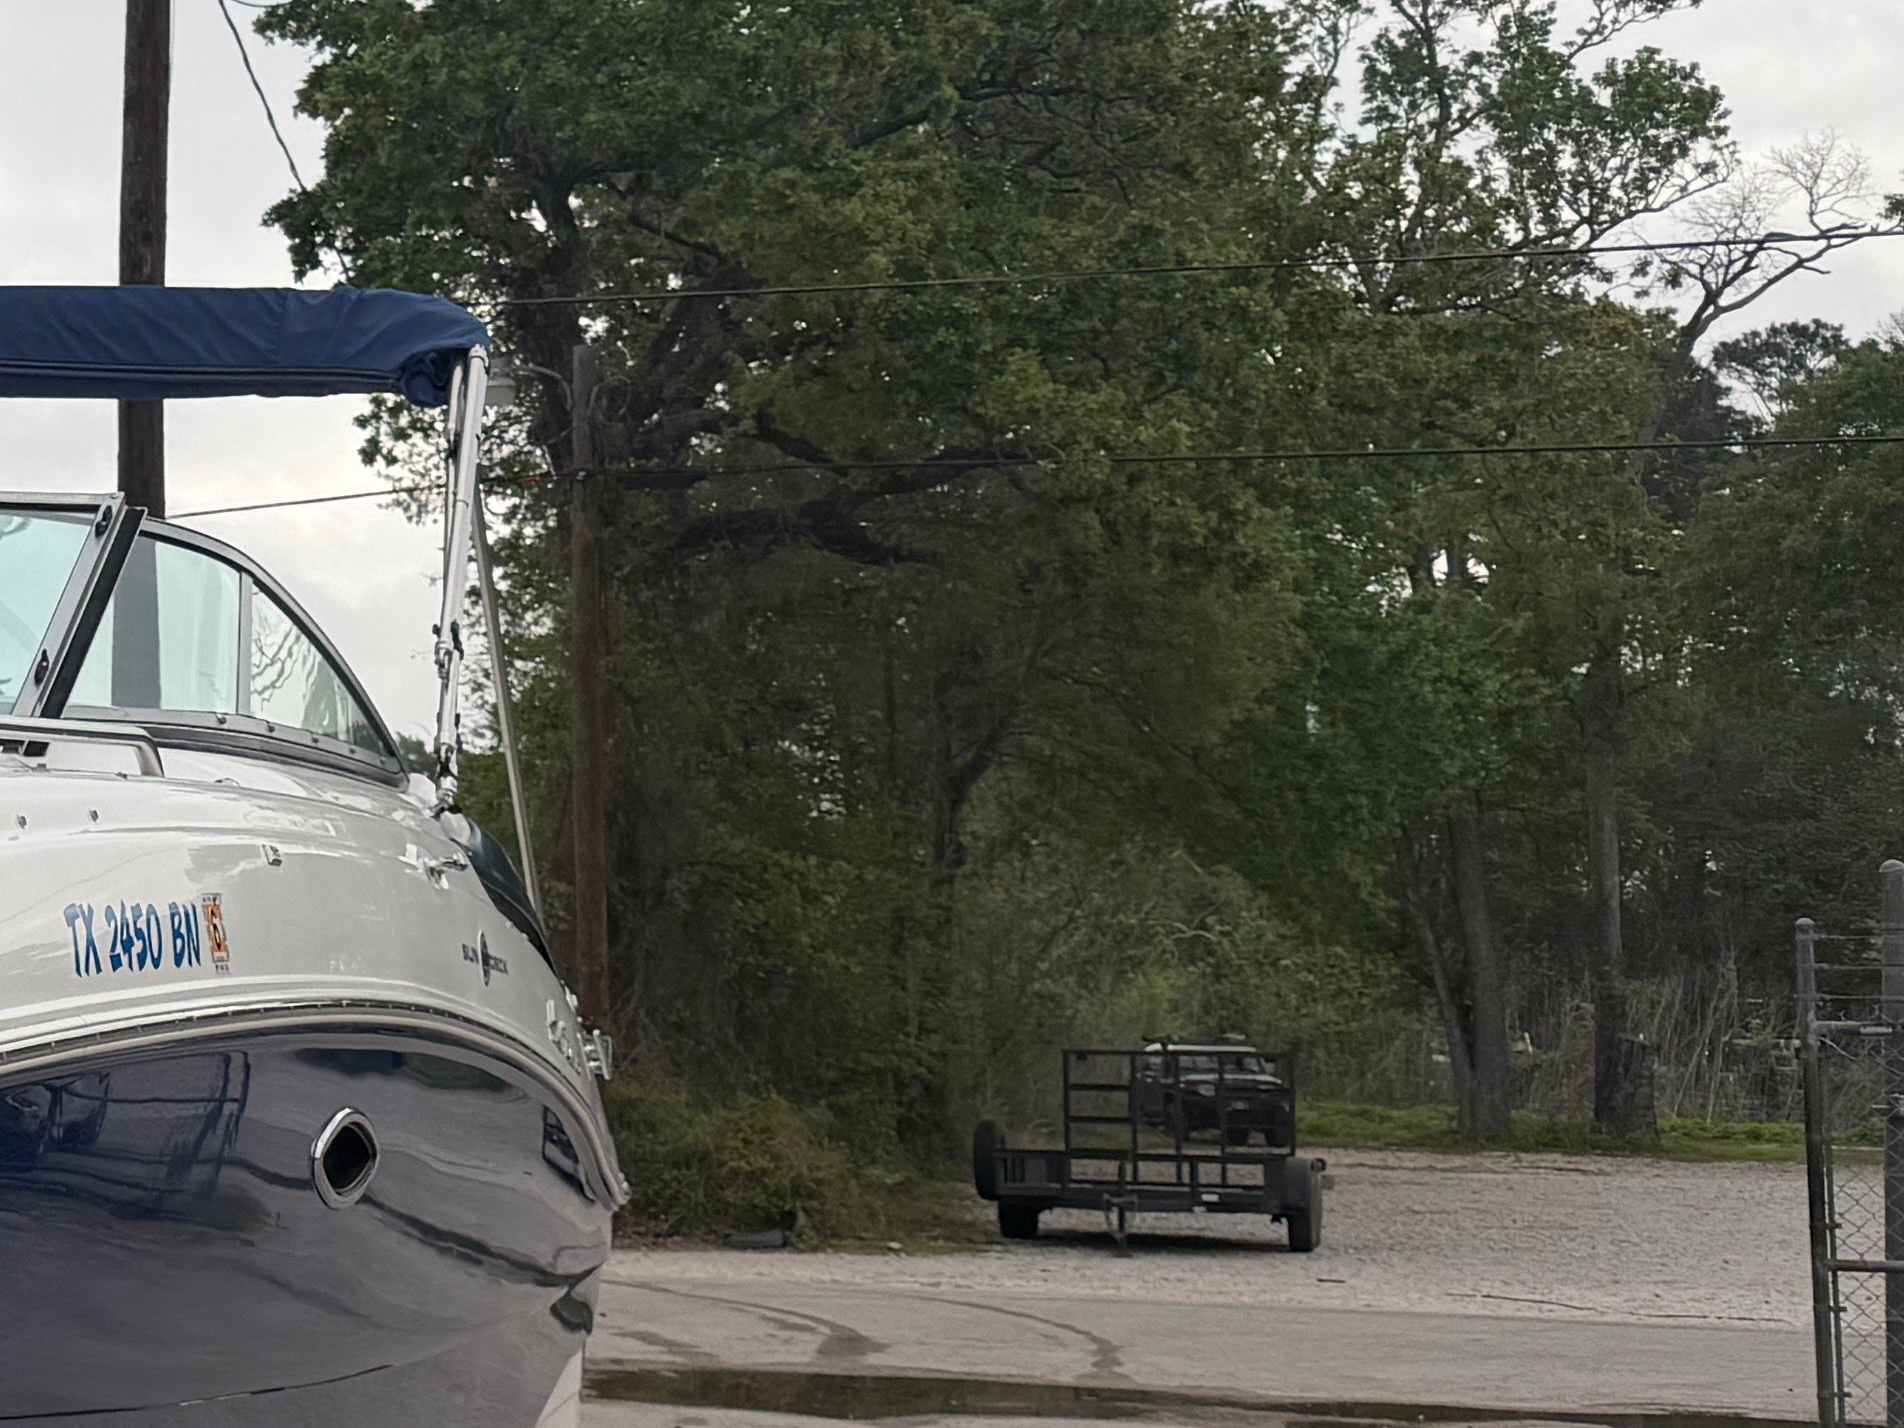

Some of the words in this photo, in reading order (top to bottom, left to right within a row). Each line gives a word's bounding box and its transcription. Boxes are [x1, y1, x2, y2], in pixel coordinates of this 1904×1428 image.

[63, 902, 103, 978] TX
[104, 899, 163, 973] 2450
[168, 901, 201, 969] BN
